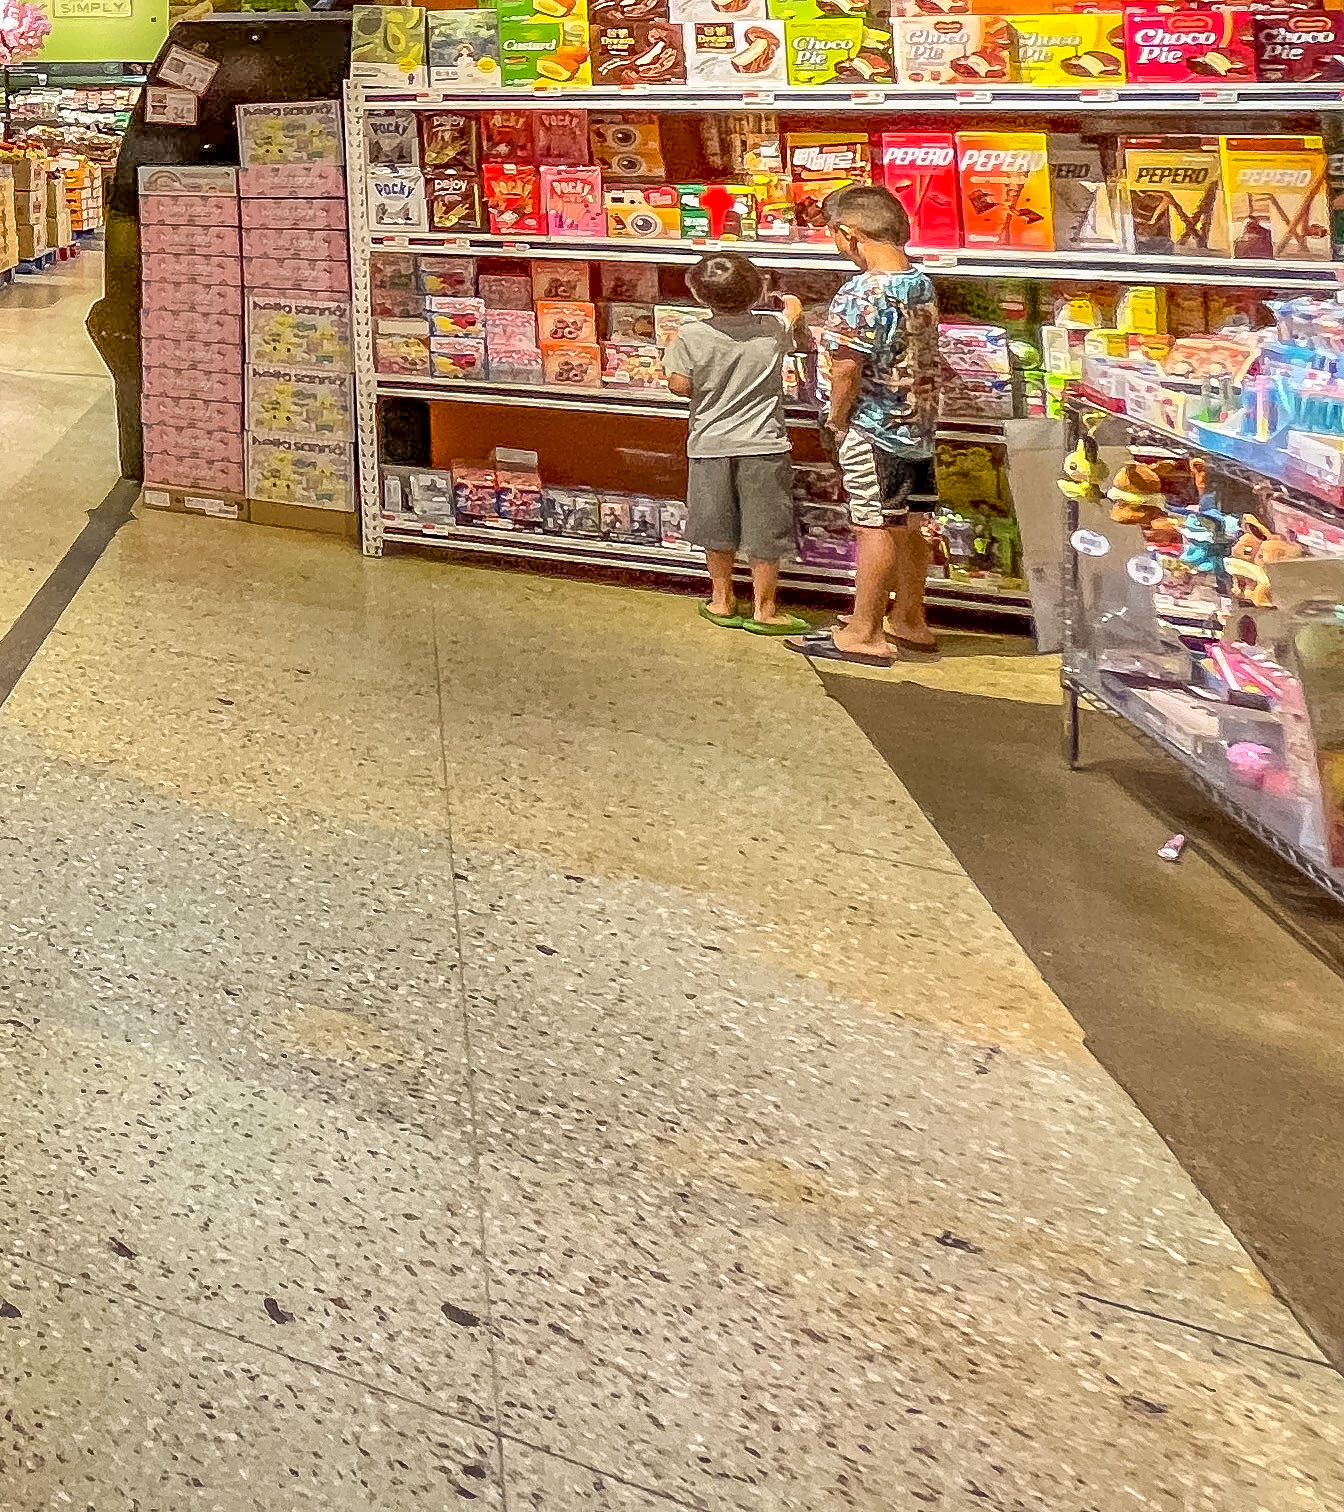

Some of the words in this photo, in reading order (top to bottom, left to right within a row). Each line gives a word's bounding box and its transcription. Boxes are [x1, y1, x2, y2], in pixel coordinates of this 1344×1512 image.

[61, 2, 124, 14] SIMPLY
[792, 37, 854, 51] Choco
[1135, 29, 1216, 46] Choco
[1260, 28, 1335, 44] Choco
[795, 51, 828, 65] Pie
[1136, 46, 1183, 64] Pie
[1262, 45, 1303, 60] Pie
[883, 147, 954, 167] PEPERO
[961, 149, 1047, 172] PEPERO
[1136, 167, 1209, 184] PEPERO
[375, 181, 415, 198] Pocky
[551, 179, 592, 196] Pocky
